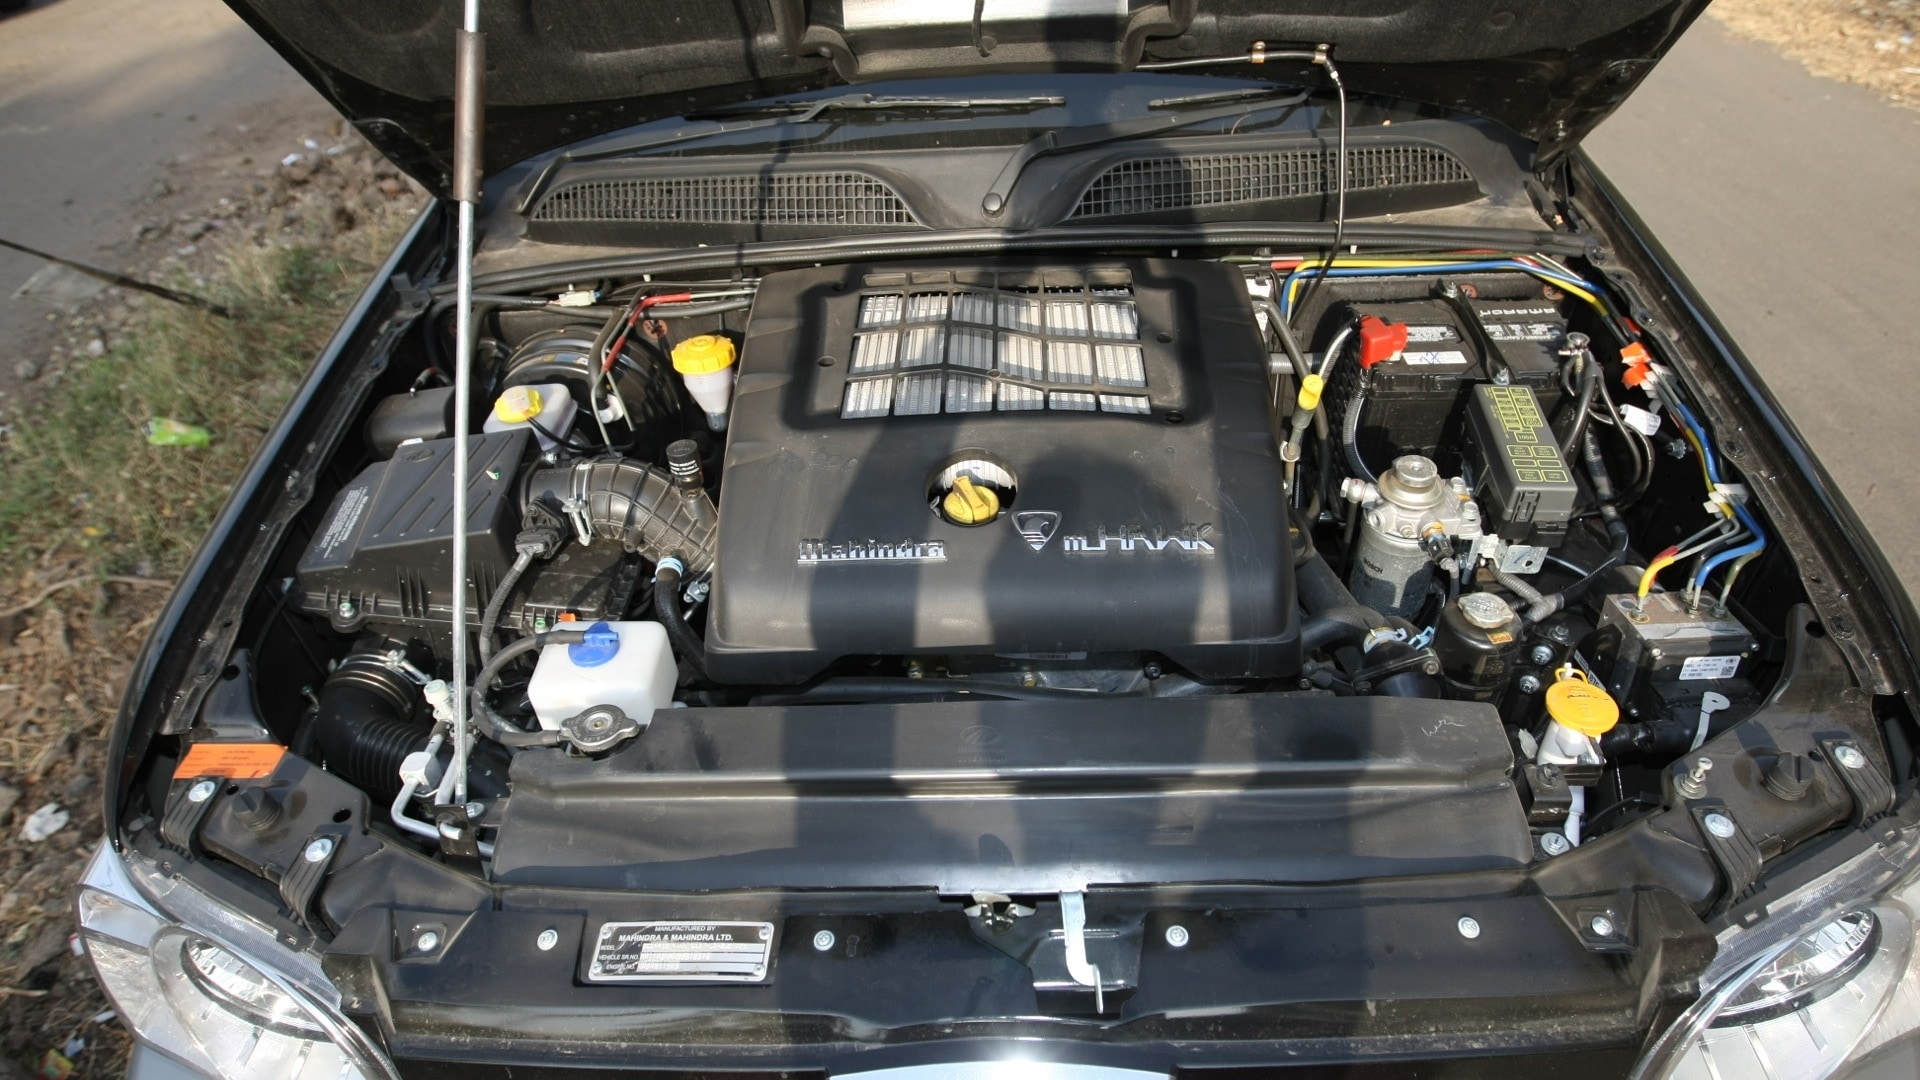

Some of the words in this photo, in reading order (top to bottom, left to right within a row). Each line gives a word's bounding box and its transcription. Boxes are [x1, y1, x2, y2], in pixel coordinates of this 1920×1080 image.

[799, 538, 948, 561] Mahindra
[618, 934, 661, 942] MAHINDRA
[671, 933, 714, 941] MAHINDRA
[716, 933, 733, 941] LTD.
